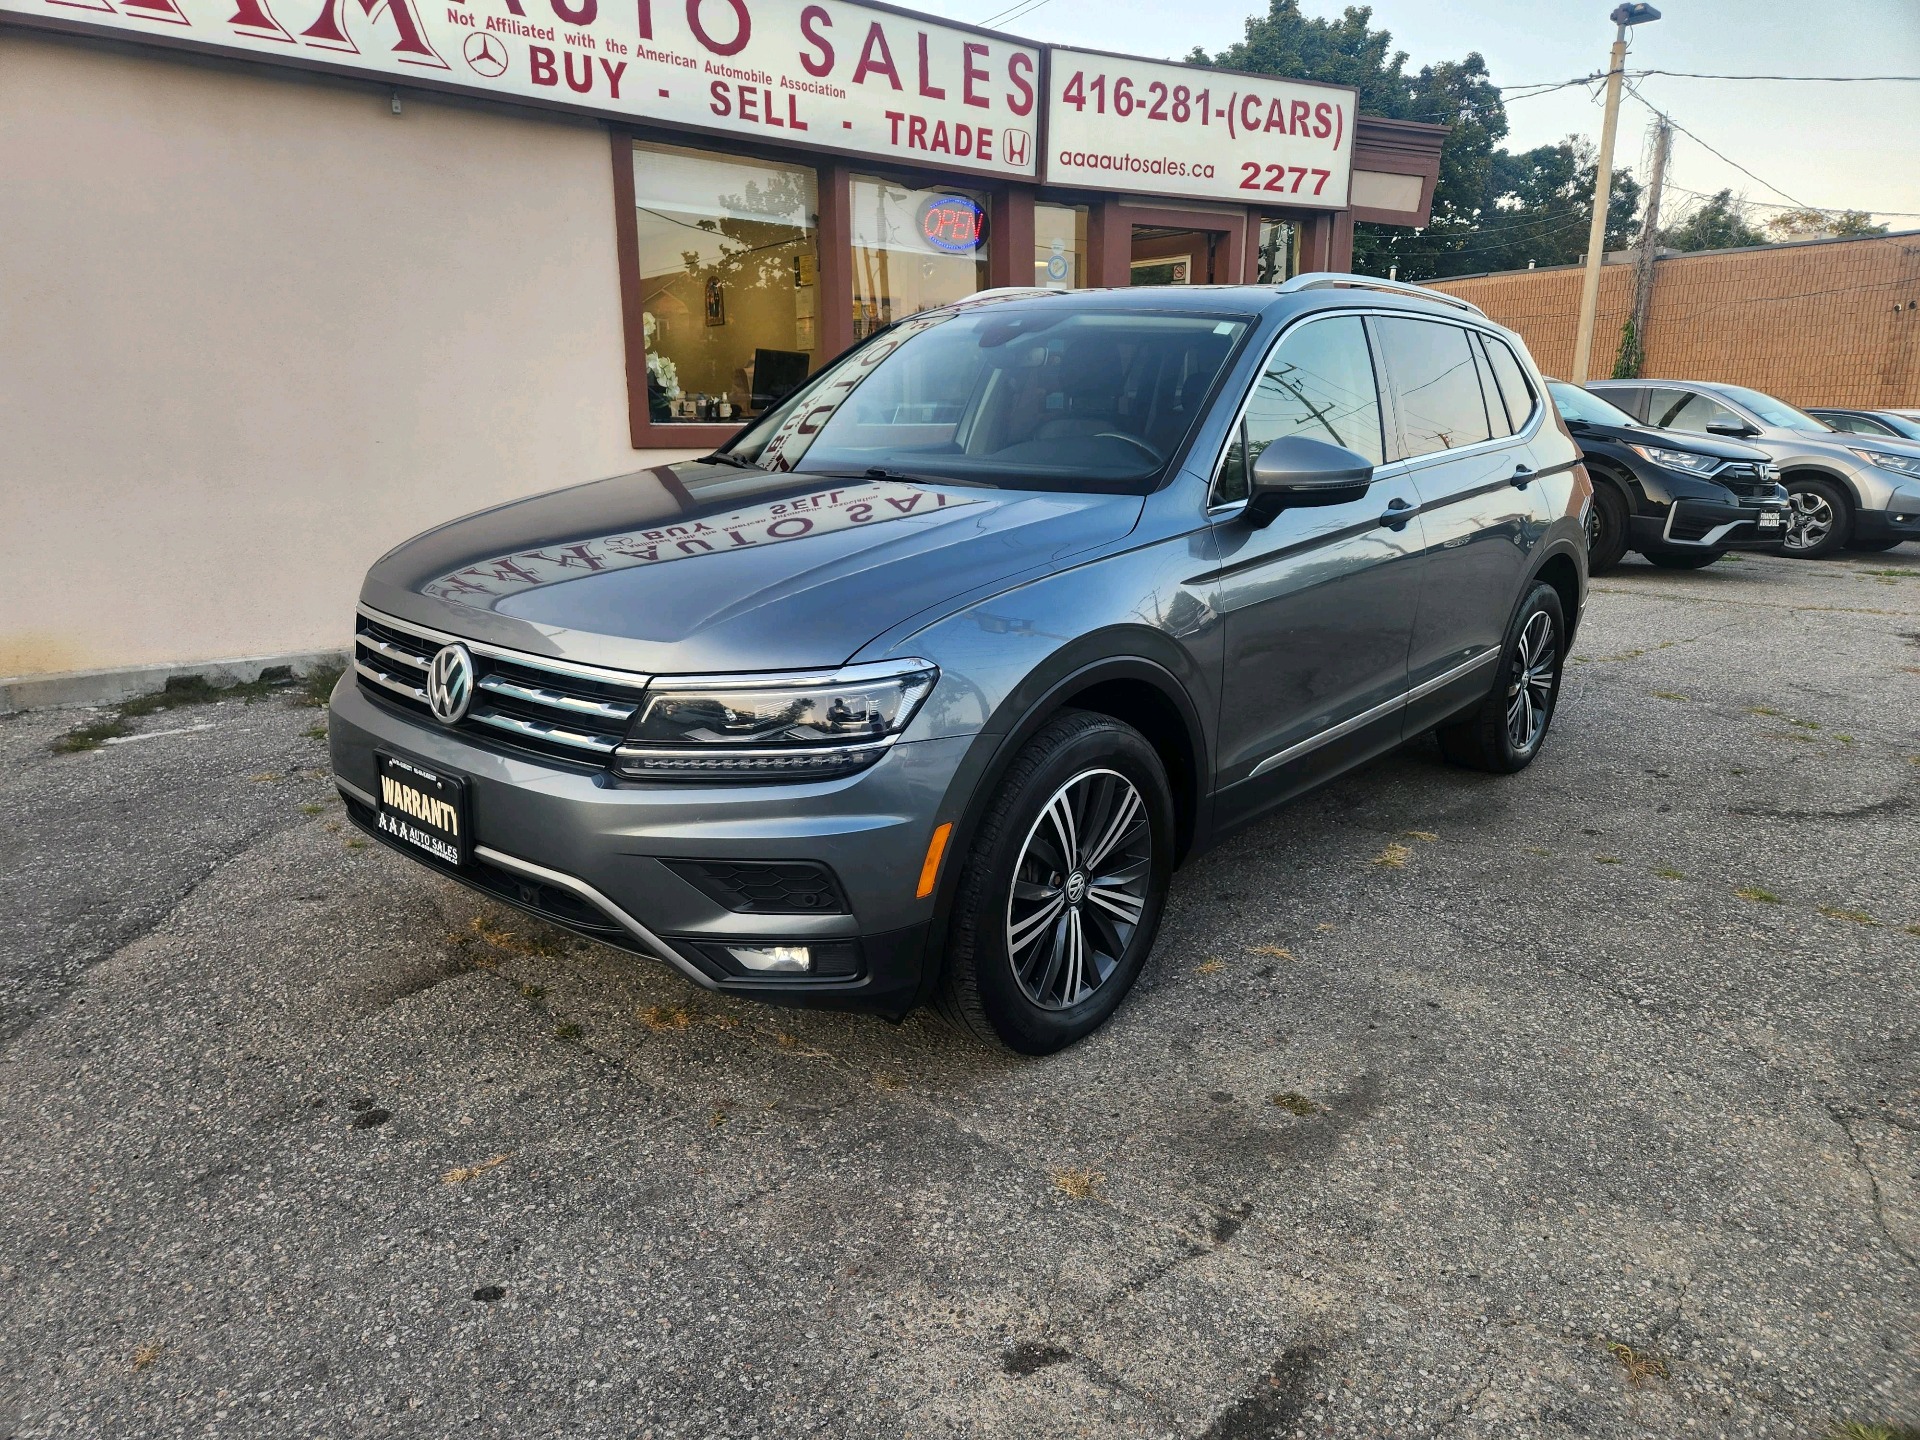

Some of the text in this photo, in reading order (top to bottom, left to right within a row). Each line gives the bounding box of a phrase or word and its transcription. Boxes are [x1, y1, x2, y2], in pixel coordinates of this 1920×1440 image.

[447, 8, 847, 99] Not Affiliated with the American Automobile Association
[799, 6, 1034, 117] SALES
[530, 45, 628, 99] BUY
[710, 80, 808, 131] SELL
[885, 111, 994, 161] TRADE
[1062, 70, 1344, 151] 416-281-(CARS)
[1059, 149, 1215, 180] aaaautosales.ca
[1239, 161, 1332, 196] 2277
[924, 208, 984, 240] OPEN
[1759, 519, 1780, 527] AVAILABLE
[381, 774, 458, 836] WARRANTY
[409, 827, 430, 846] AUTO
[432, 838, 458, 859] SALES
